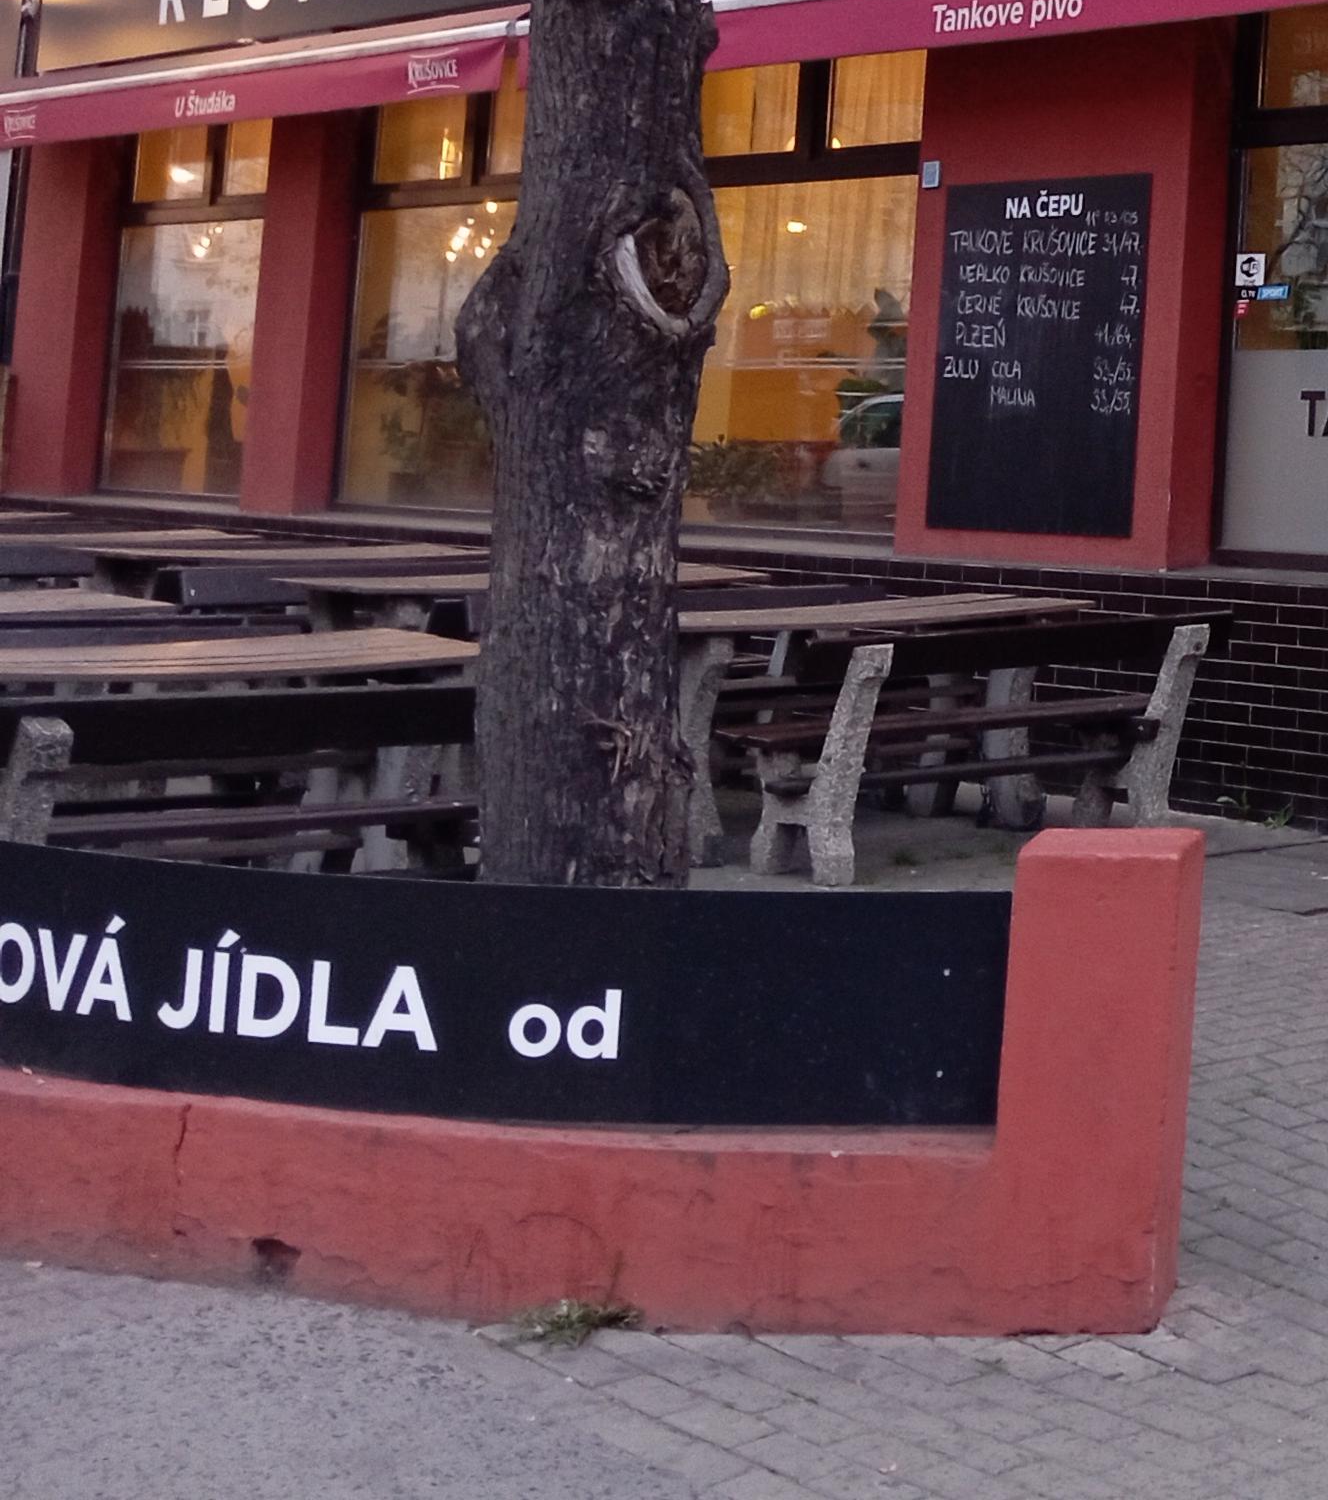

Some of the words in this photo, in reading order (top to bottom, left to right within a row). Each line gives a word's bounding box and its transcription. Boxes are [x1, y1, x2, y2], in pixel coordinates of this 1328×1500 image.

[174, 96, 185, 118] U
[186, 89, 236, 117] Študáka
[1005, 197, 1031, 219] NA
[1036, 190, 1084, 217] ČEPU
[1022, 224, 1098, 257] KRUŠOVICE
[957, 290, 1002, 315] ČERNÉ
[955, 318, 1006, 348] PLZEŇ
[157, 928, 438, 1052] JÍDLA
[508, 988, 623, 1060] od
